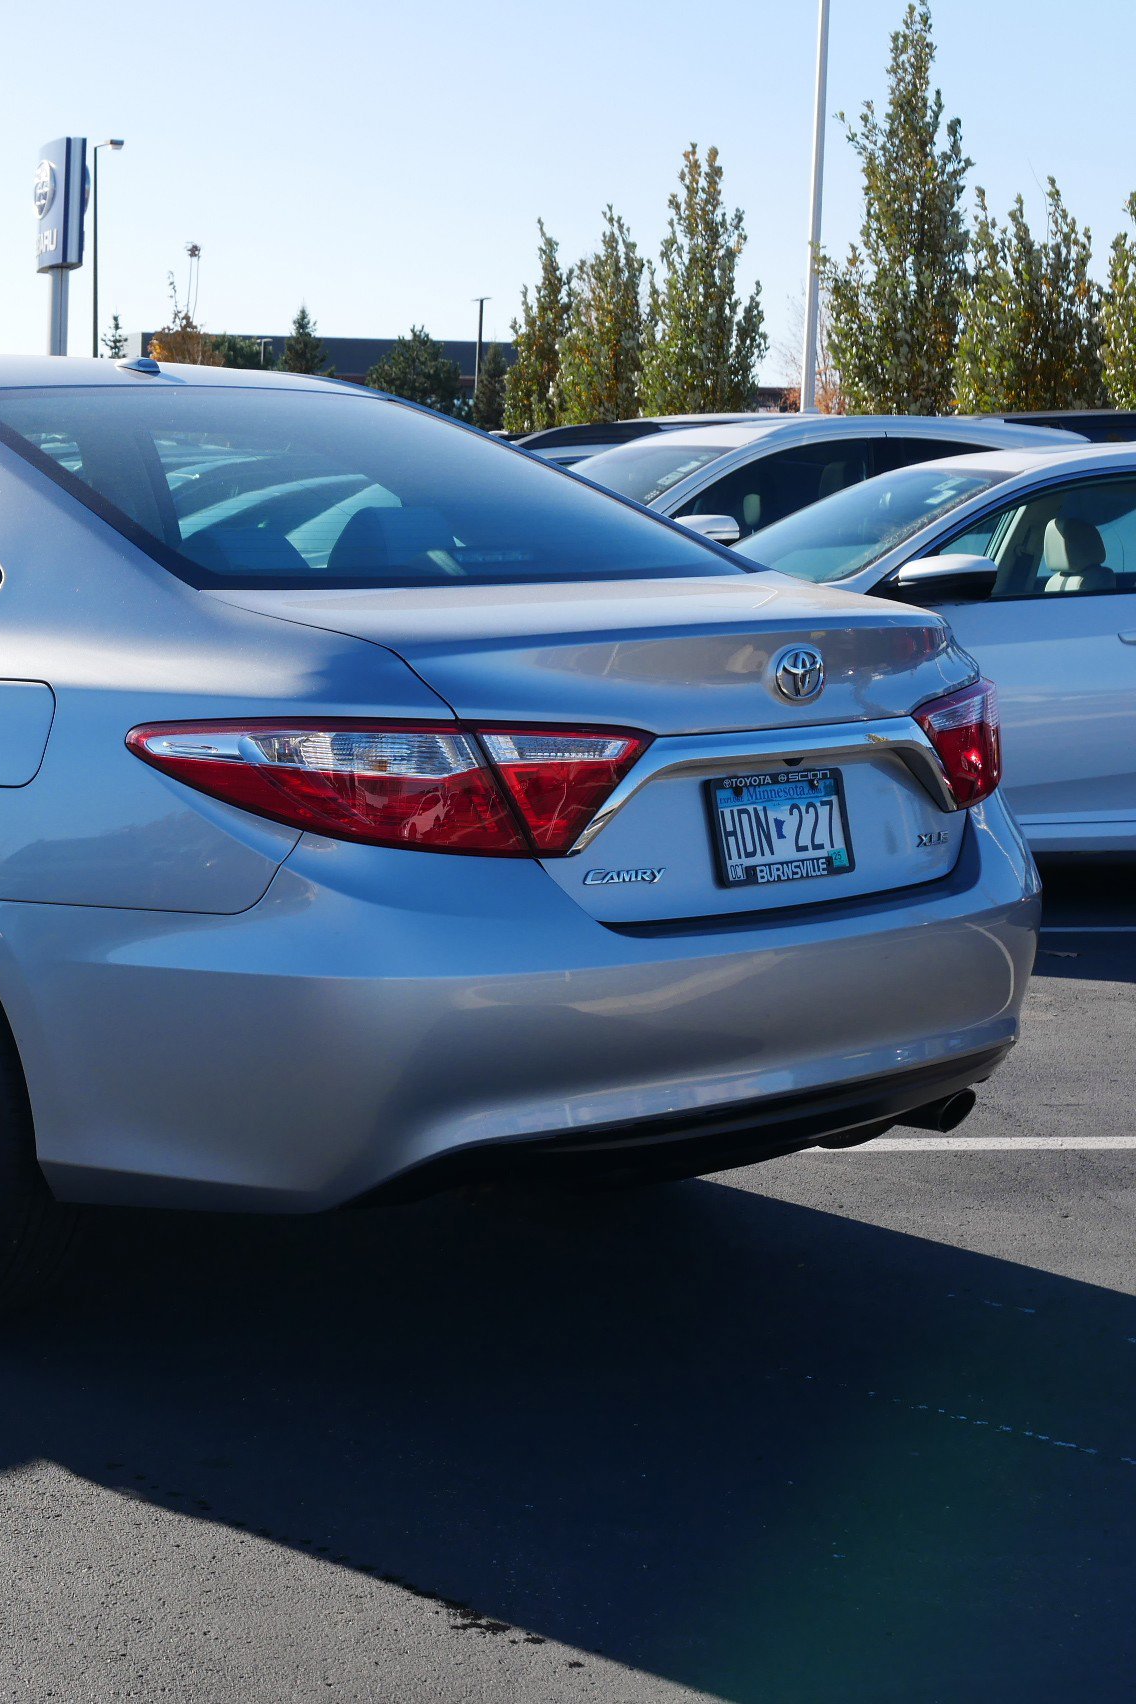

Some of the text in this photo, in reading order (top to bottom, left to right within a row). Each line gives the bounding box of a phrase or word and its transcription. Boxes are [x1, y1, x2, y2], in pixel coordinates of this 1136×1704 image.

[730, 775, 772, 787] TOYOTA
[720, 799, 835, 860] HDN 227
[583, 868, 666, 885] CAMRY
[729, 863, 745, 880] OCT
[756, 858, 828, 883] BURNSVILLE
